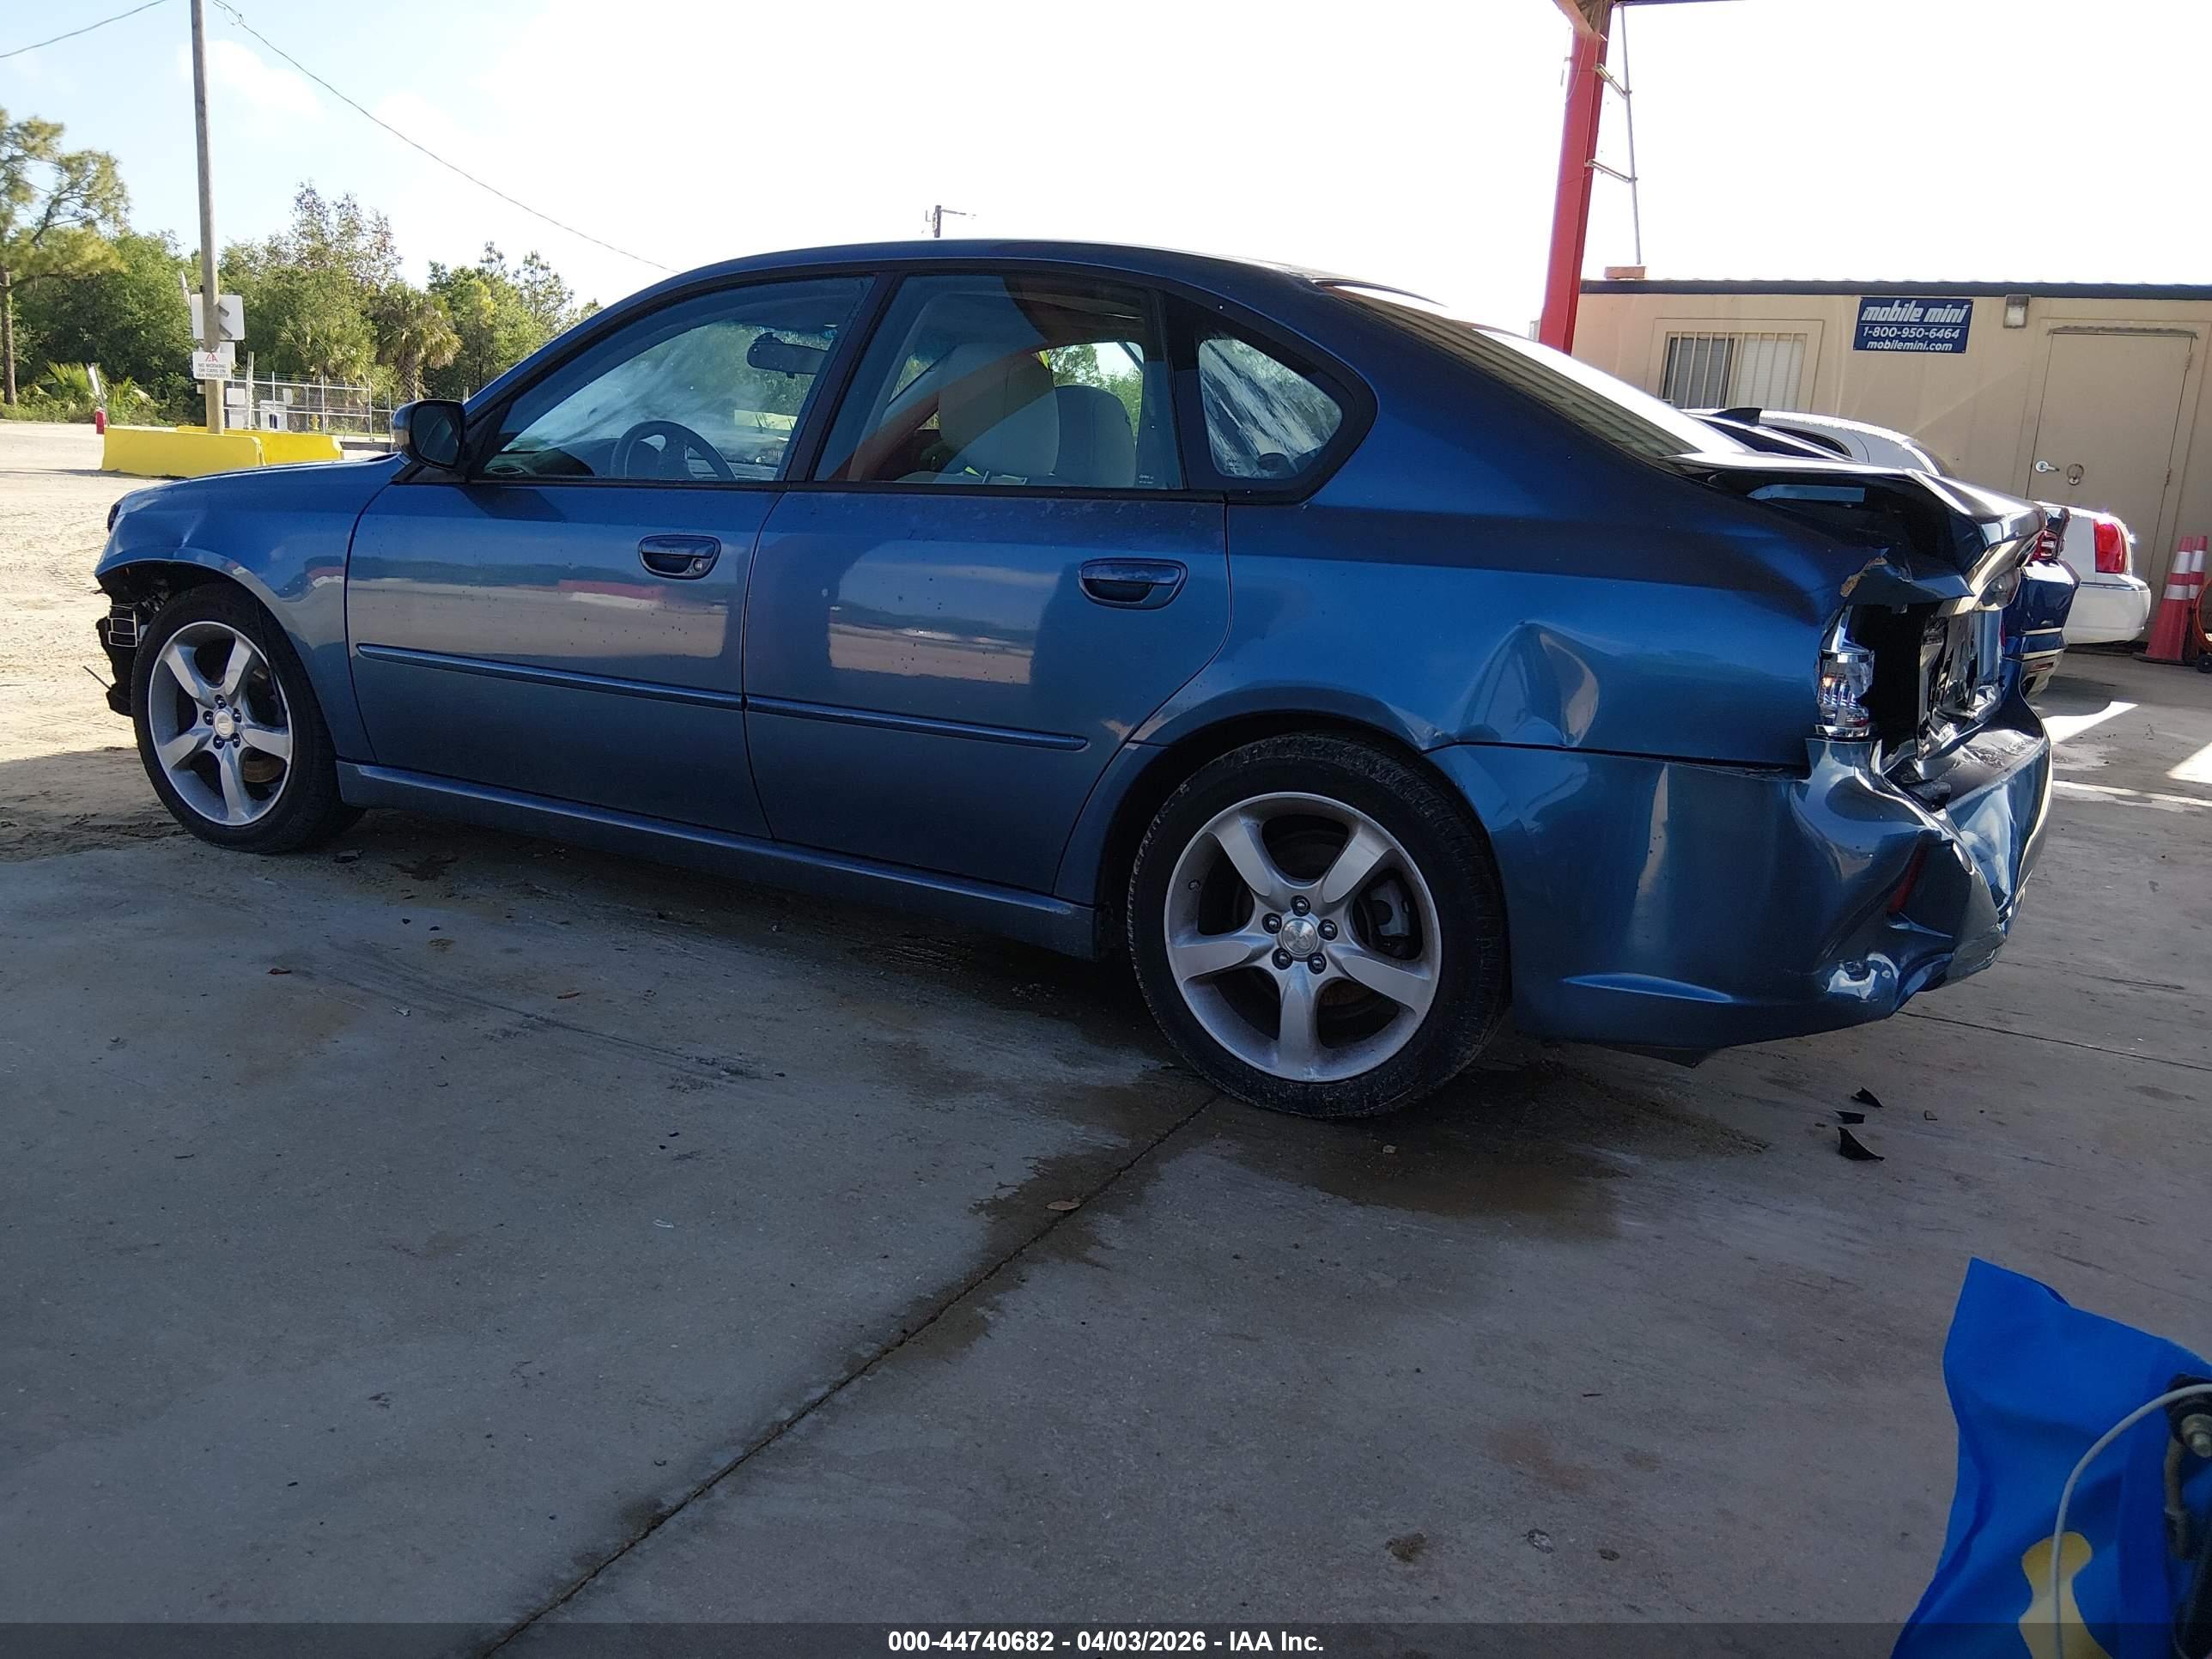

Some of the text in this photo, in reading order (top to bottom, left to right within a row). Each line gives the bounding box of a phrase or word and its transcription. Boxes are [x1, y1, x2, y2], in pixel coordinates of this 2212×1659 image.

[1861, 300, 1969, 324] mobile mini
[1863, 326, 1960, 339] 1-800-950-6464
[1866, 339, 1953, 351] mobilemini.com
